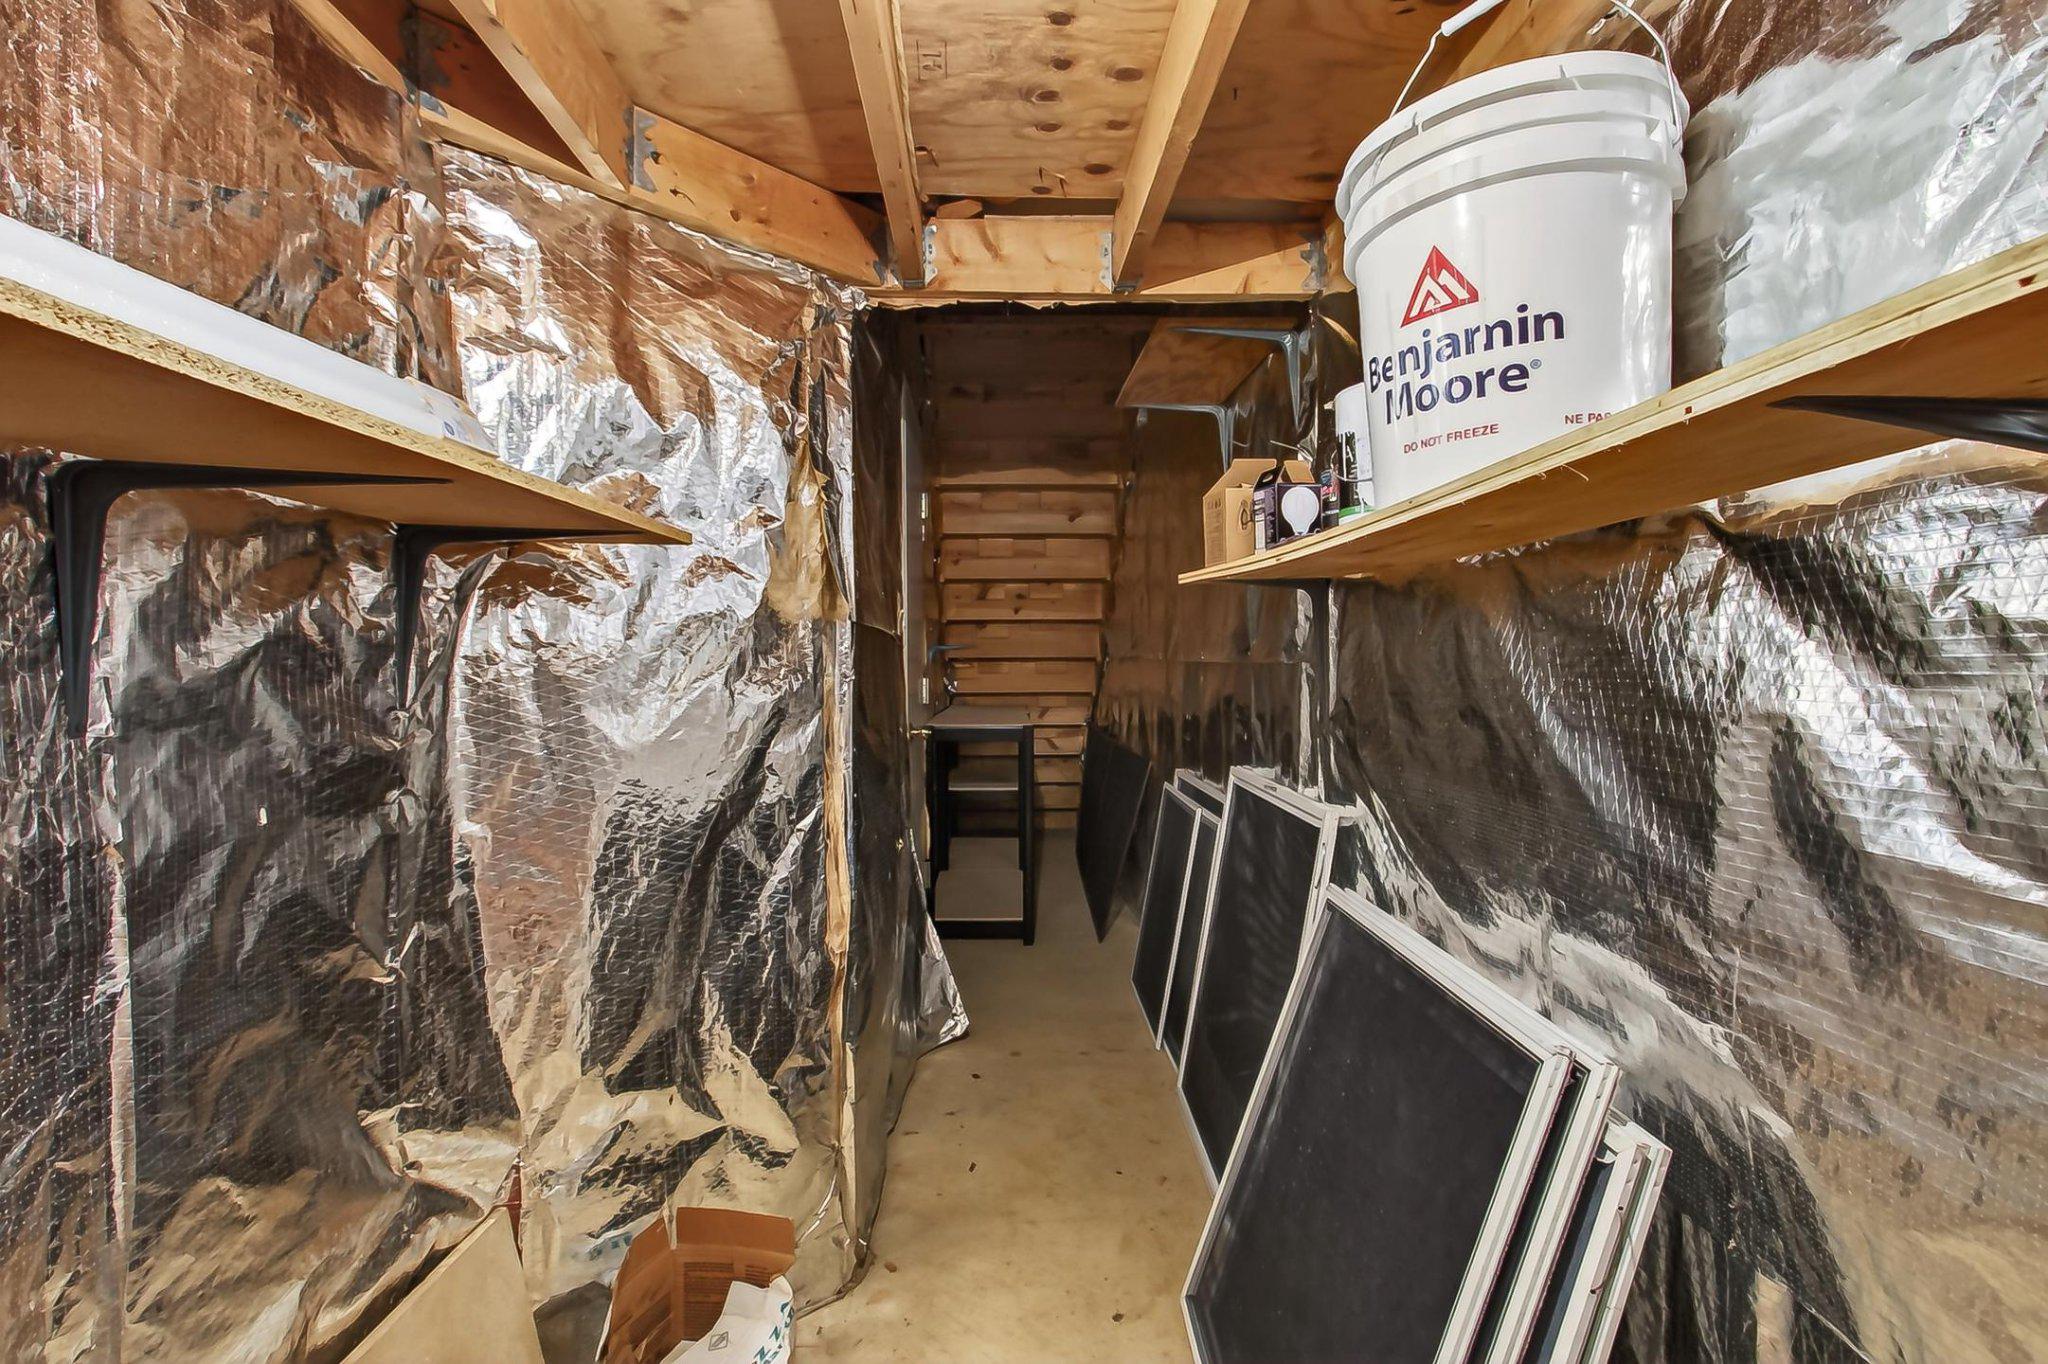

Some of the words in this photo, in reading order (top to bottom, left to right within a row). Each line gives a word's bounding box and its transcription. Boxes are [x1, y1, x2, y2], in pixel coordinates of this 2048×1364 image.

[1565, 414, 1583, 424] NE
[1403, 442, 1419, 454] DO
[1421, 435, 1443, 449] NOT
[1446, 423, 1499, 443] FREEZE
